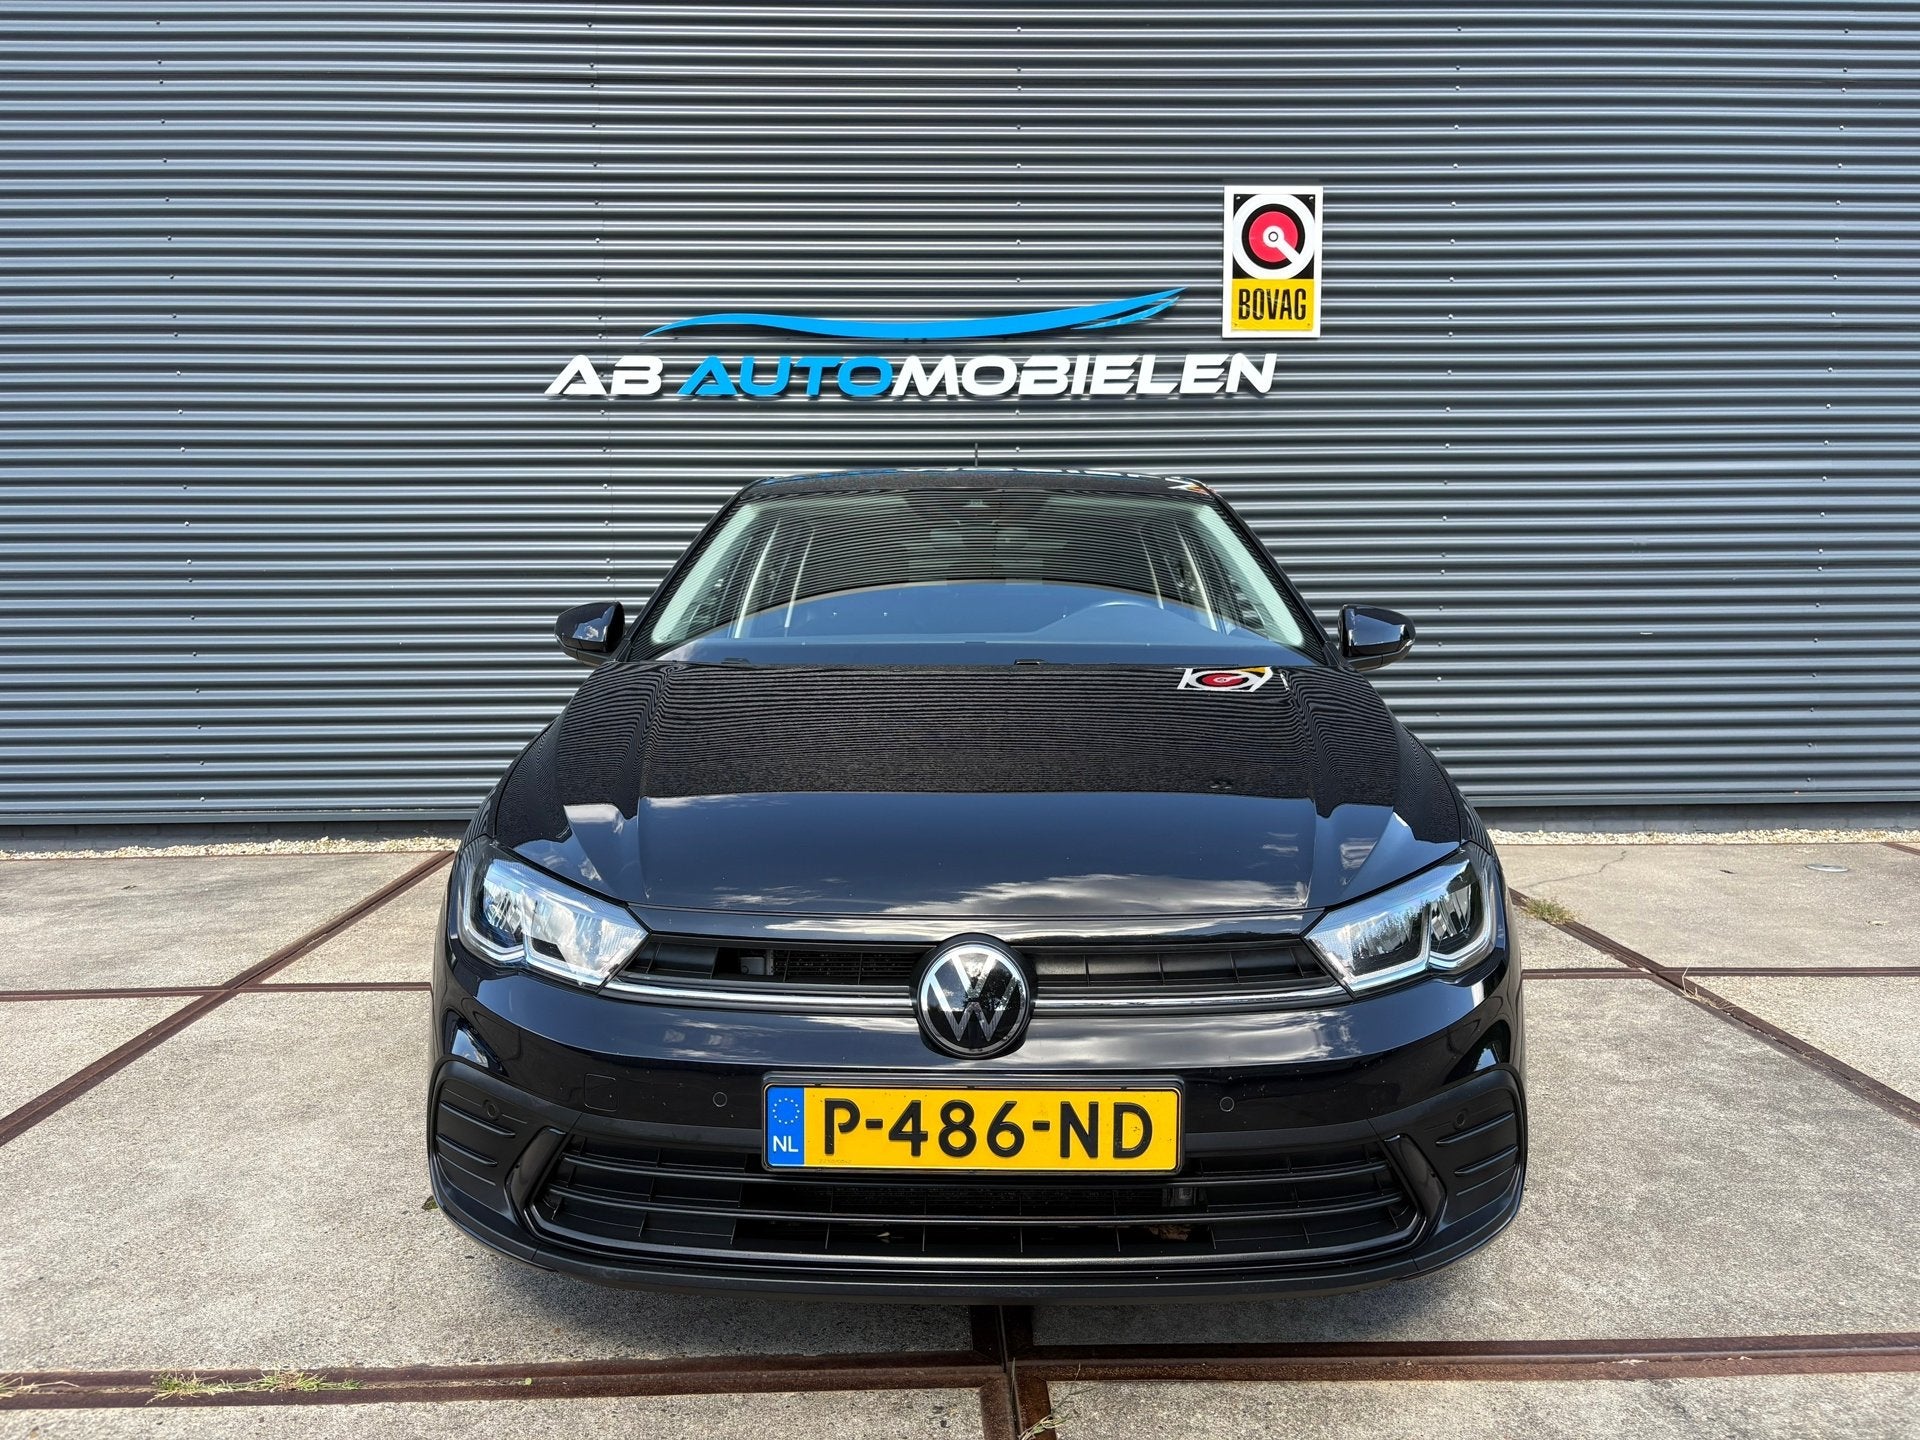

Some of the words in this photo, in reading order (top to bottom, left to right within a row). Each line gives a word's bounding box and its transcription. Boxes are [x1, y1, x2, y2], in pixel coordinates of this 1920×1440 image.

[1238, 288, 1307, 321] BOVAG
[544, 354, 664, 396] AB
[677, 353, 1278, 397] AUTOMOBIELEN
[772, 1135, 799, 1153] NL
[824, 1097, 1153, 1159] P-486-ND
